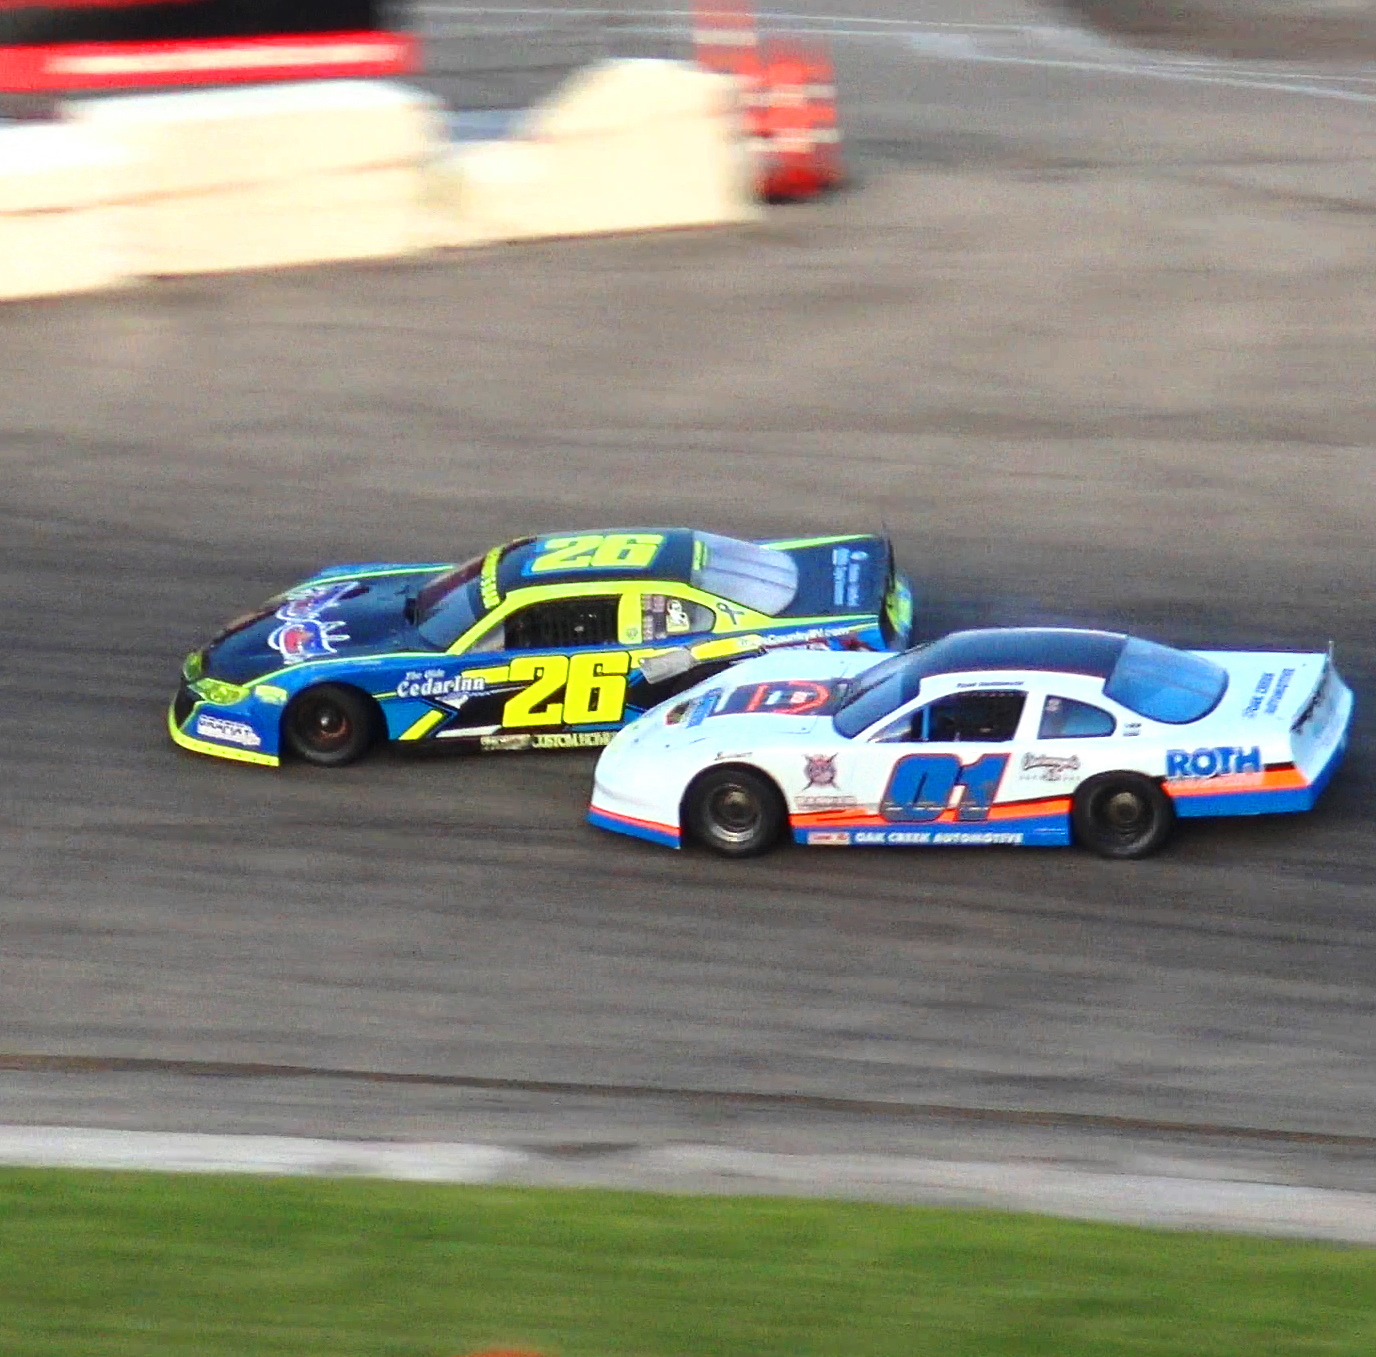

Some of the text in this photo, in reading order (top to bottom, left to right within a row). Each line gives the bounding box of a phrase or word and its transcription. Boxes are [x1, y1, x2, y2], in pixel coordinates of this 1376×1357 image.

[531, 534, 664, 572] 26
[501, 651, 632, 728] 26
[1166, 746, 1260, 777] ROTH
[878, 752, 1012, 823] 01
[855, 832, 886, 844] OAK
[887, 832, 932, 844] CREEK
[932, 832, 1024, 845] AUTOMOTIVE
